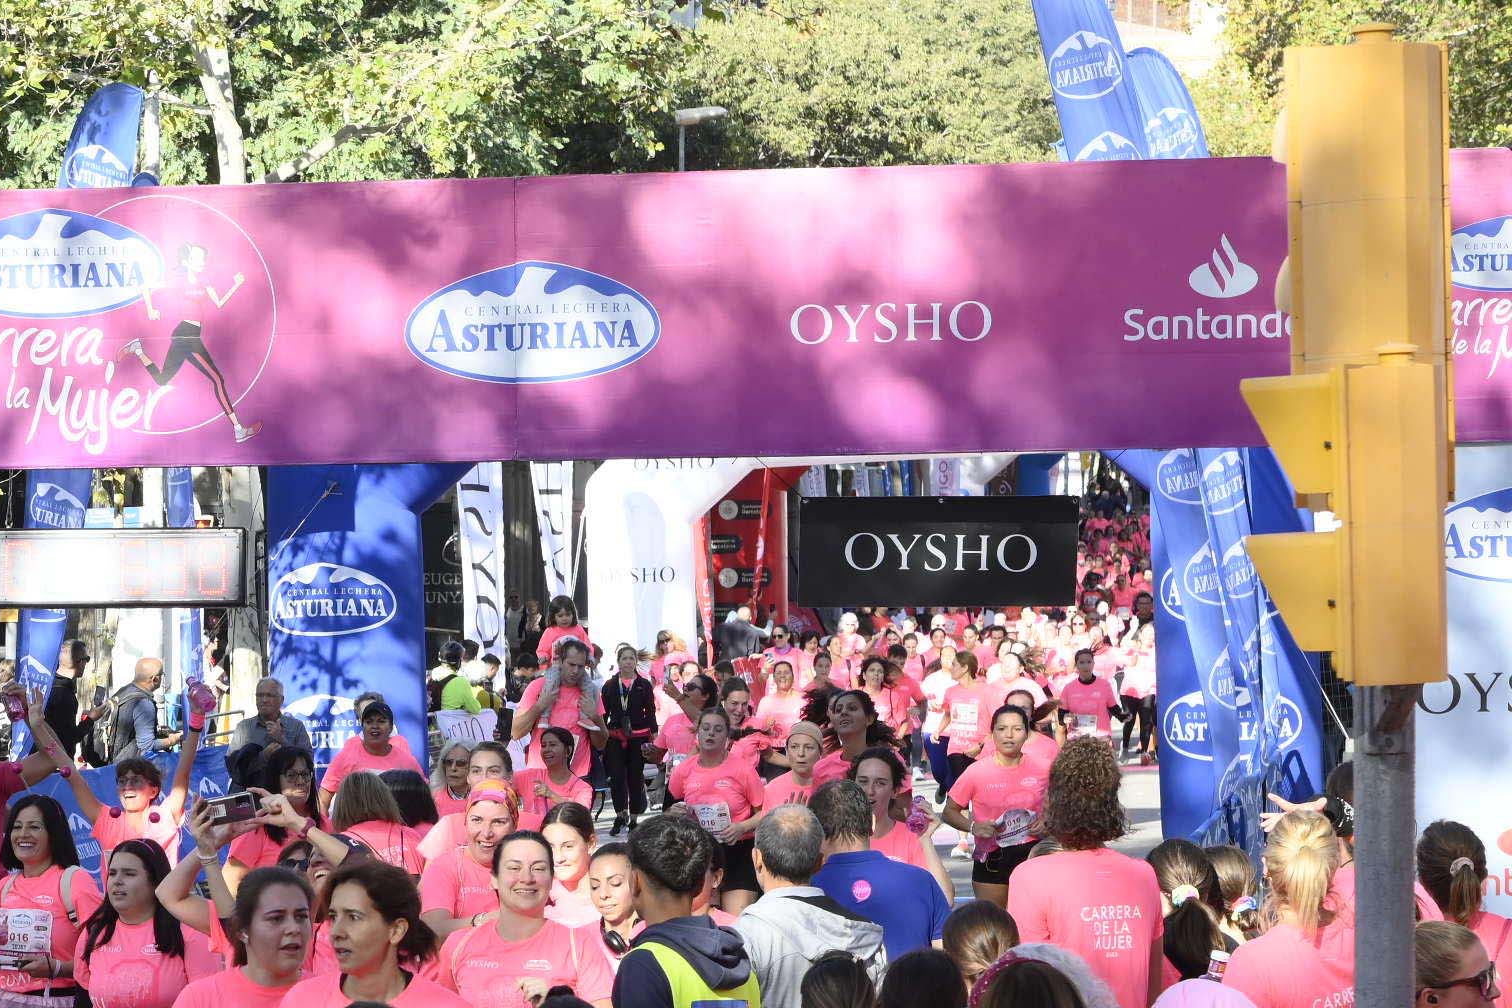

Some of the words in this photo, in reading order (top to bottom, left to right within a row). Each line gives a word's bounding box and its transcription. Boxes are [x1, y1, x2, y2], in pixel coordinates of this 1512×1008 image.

[464, 303, 544, 317] CENTRAL
[550, 301, 633, 314] LECHERA
[424, 308, 641, 353] ASTURIANA
[790, 300, 993, 346] OYSHO
[5, 370, 30, 410] la
[25, 360, 175, 456] Mujer
[844, 532, 1039, 572] OYSHO
[287, 588, 329, 596] CENTRAL
[333, 587, 383, 595] LECHERA
[274, 593, 387, 619] ASTURIANA
[1080, 904, 1143, 923] CARRERA
[9, 932, 29, 943] 016
[1094, 921, 1110, 936] DE
[1114, 921, 1130, 935] LA
[1095, 935, 1133, 950] MUJER
